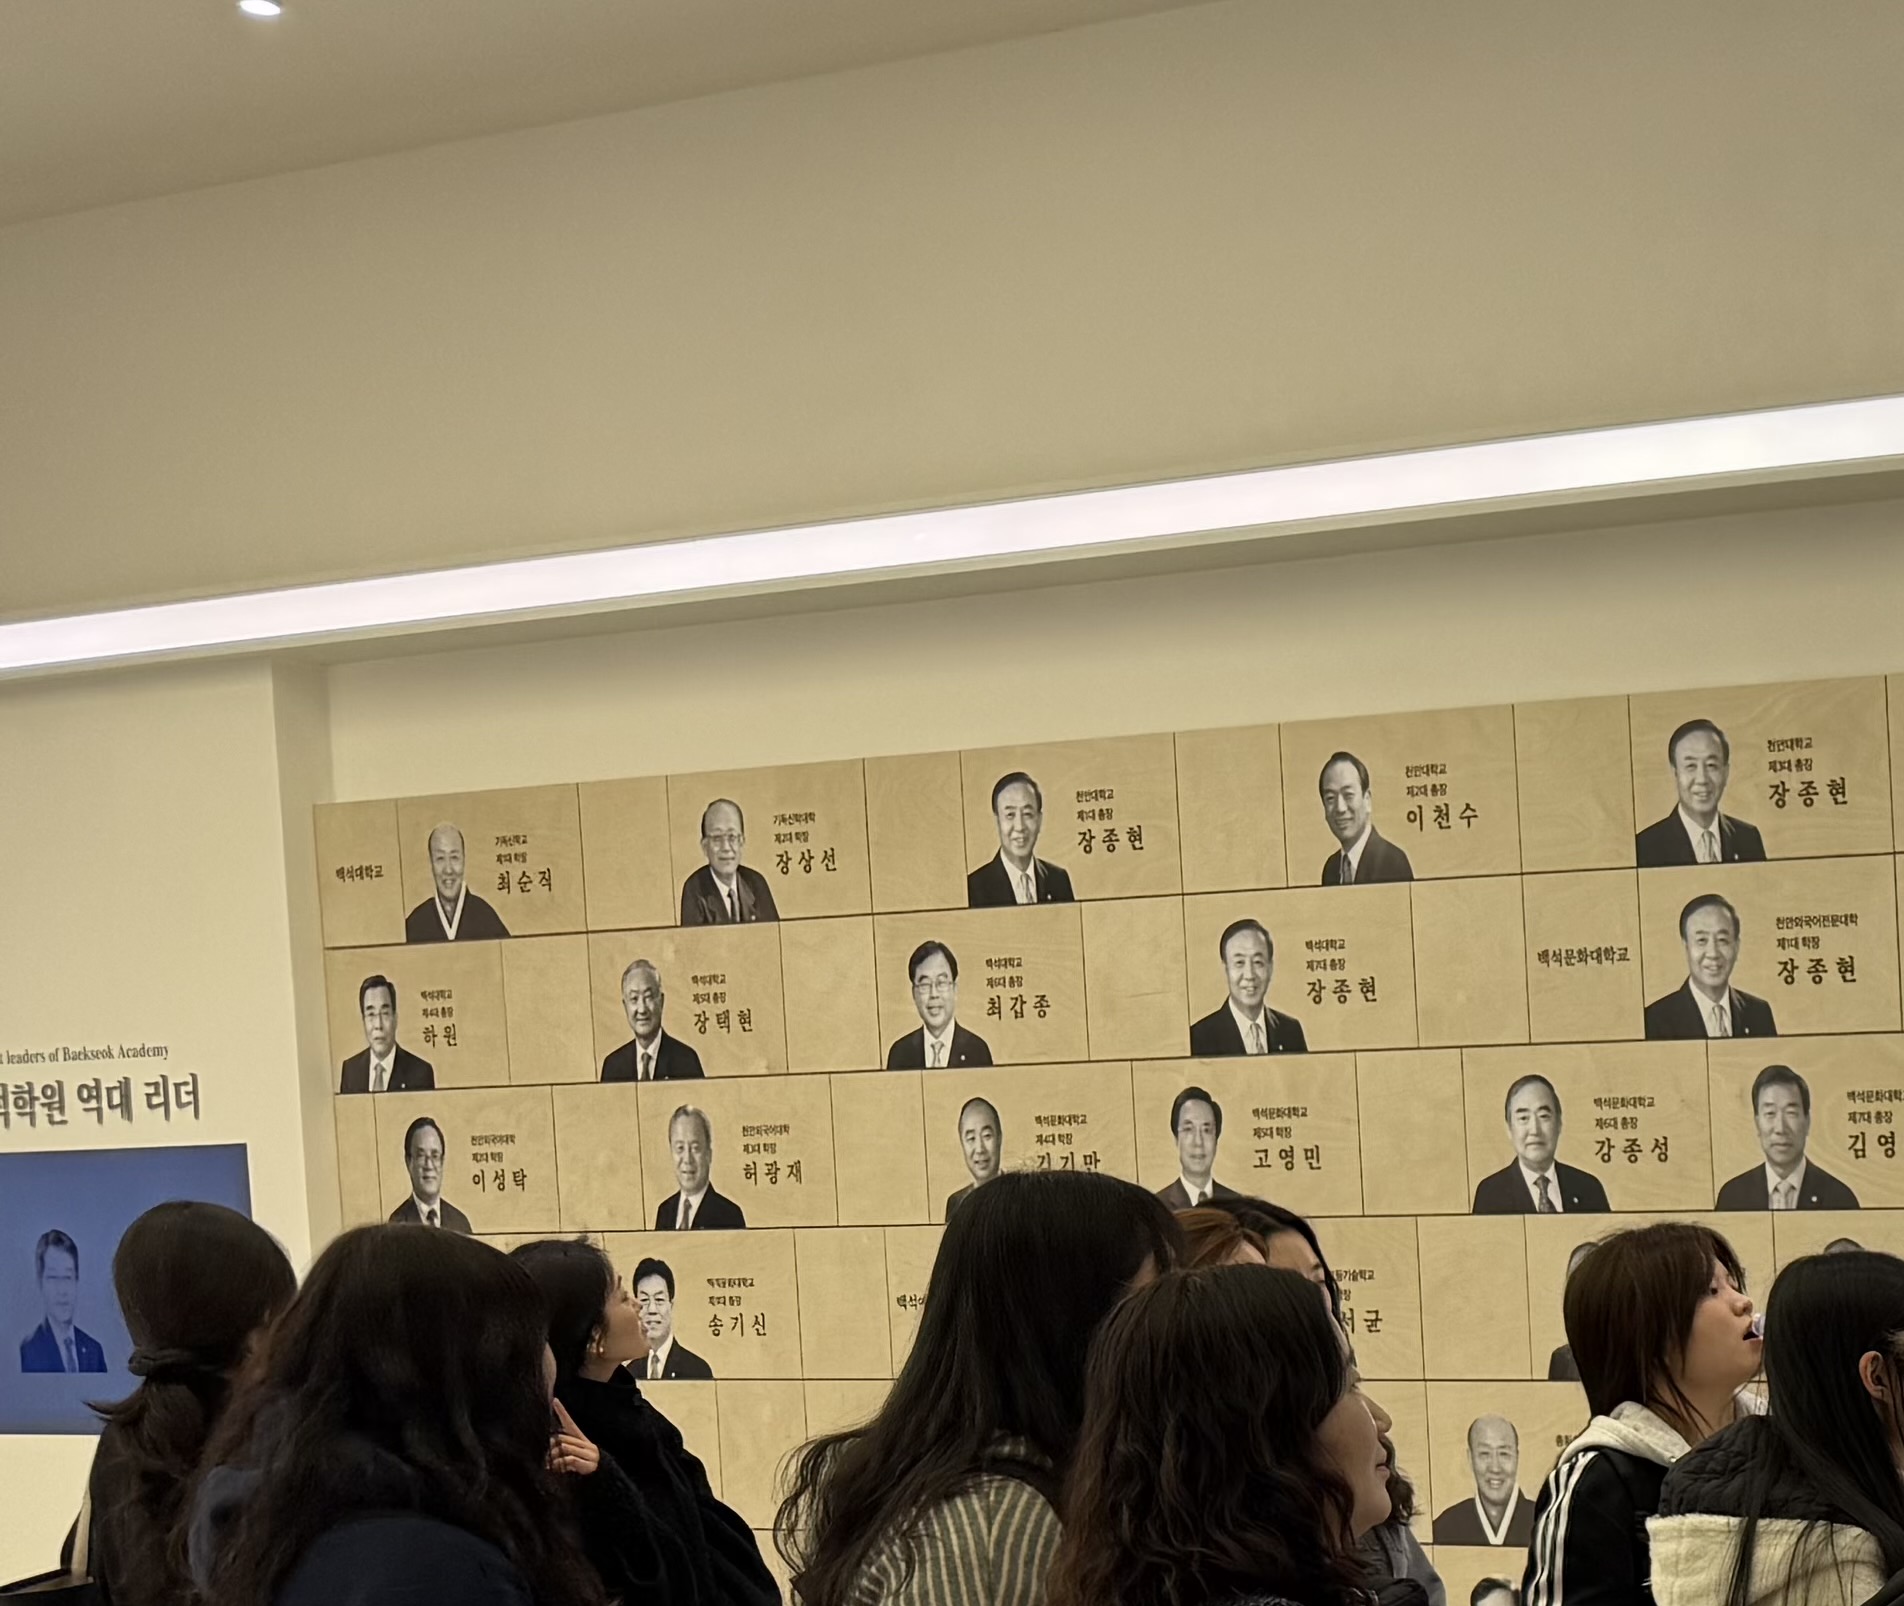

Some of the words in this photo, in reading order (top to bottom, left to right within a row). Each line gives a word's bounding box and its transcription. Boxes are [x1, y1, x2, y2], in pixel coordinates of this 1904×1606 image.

[1769, 777, 1848, 809] 장종현
[1407, 803, 1478, 832] 이천수
[1078, 825, 1144, 854] 장종현
[776, 847, 837, 875] 장상선
[497, 868, 551, 894] 최순직
[1537, 946, 1630, 968] 백석문화대학교
[1778, 955, 1856, 985] 장종현
[1307, 976, 1377, 1004] 장종현
[987, 994, 1050, 1020] 최갑종
[694, 1008, 752, 1035] 장택현
[423, 1024, 457, 1048] 하원
[6, 1049, 46, 1065] leaders
[48, 1047, 60, 1063] of
[63, 1045, 115, 1062] Baekseok
[118, 1043, 169, 1060] Academy
[76, 1076, 134, 1127] 역대
[144, 1073, 200, 1121] 리더
[1253, 1145, 1321, 1171] 고영민
[1595, 1136, 1668, 1163] 강종성
[472, 1168, 527, 1192] 이성탁
[743, 1160, 802, 1186] 허광재
[709, 1313, 766, 1337] 송기신
